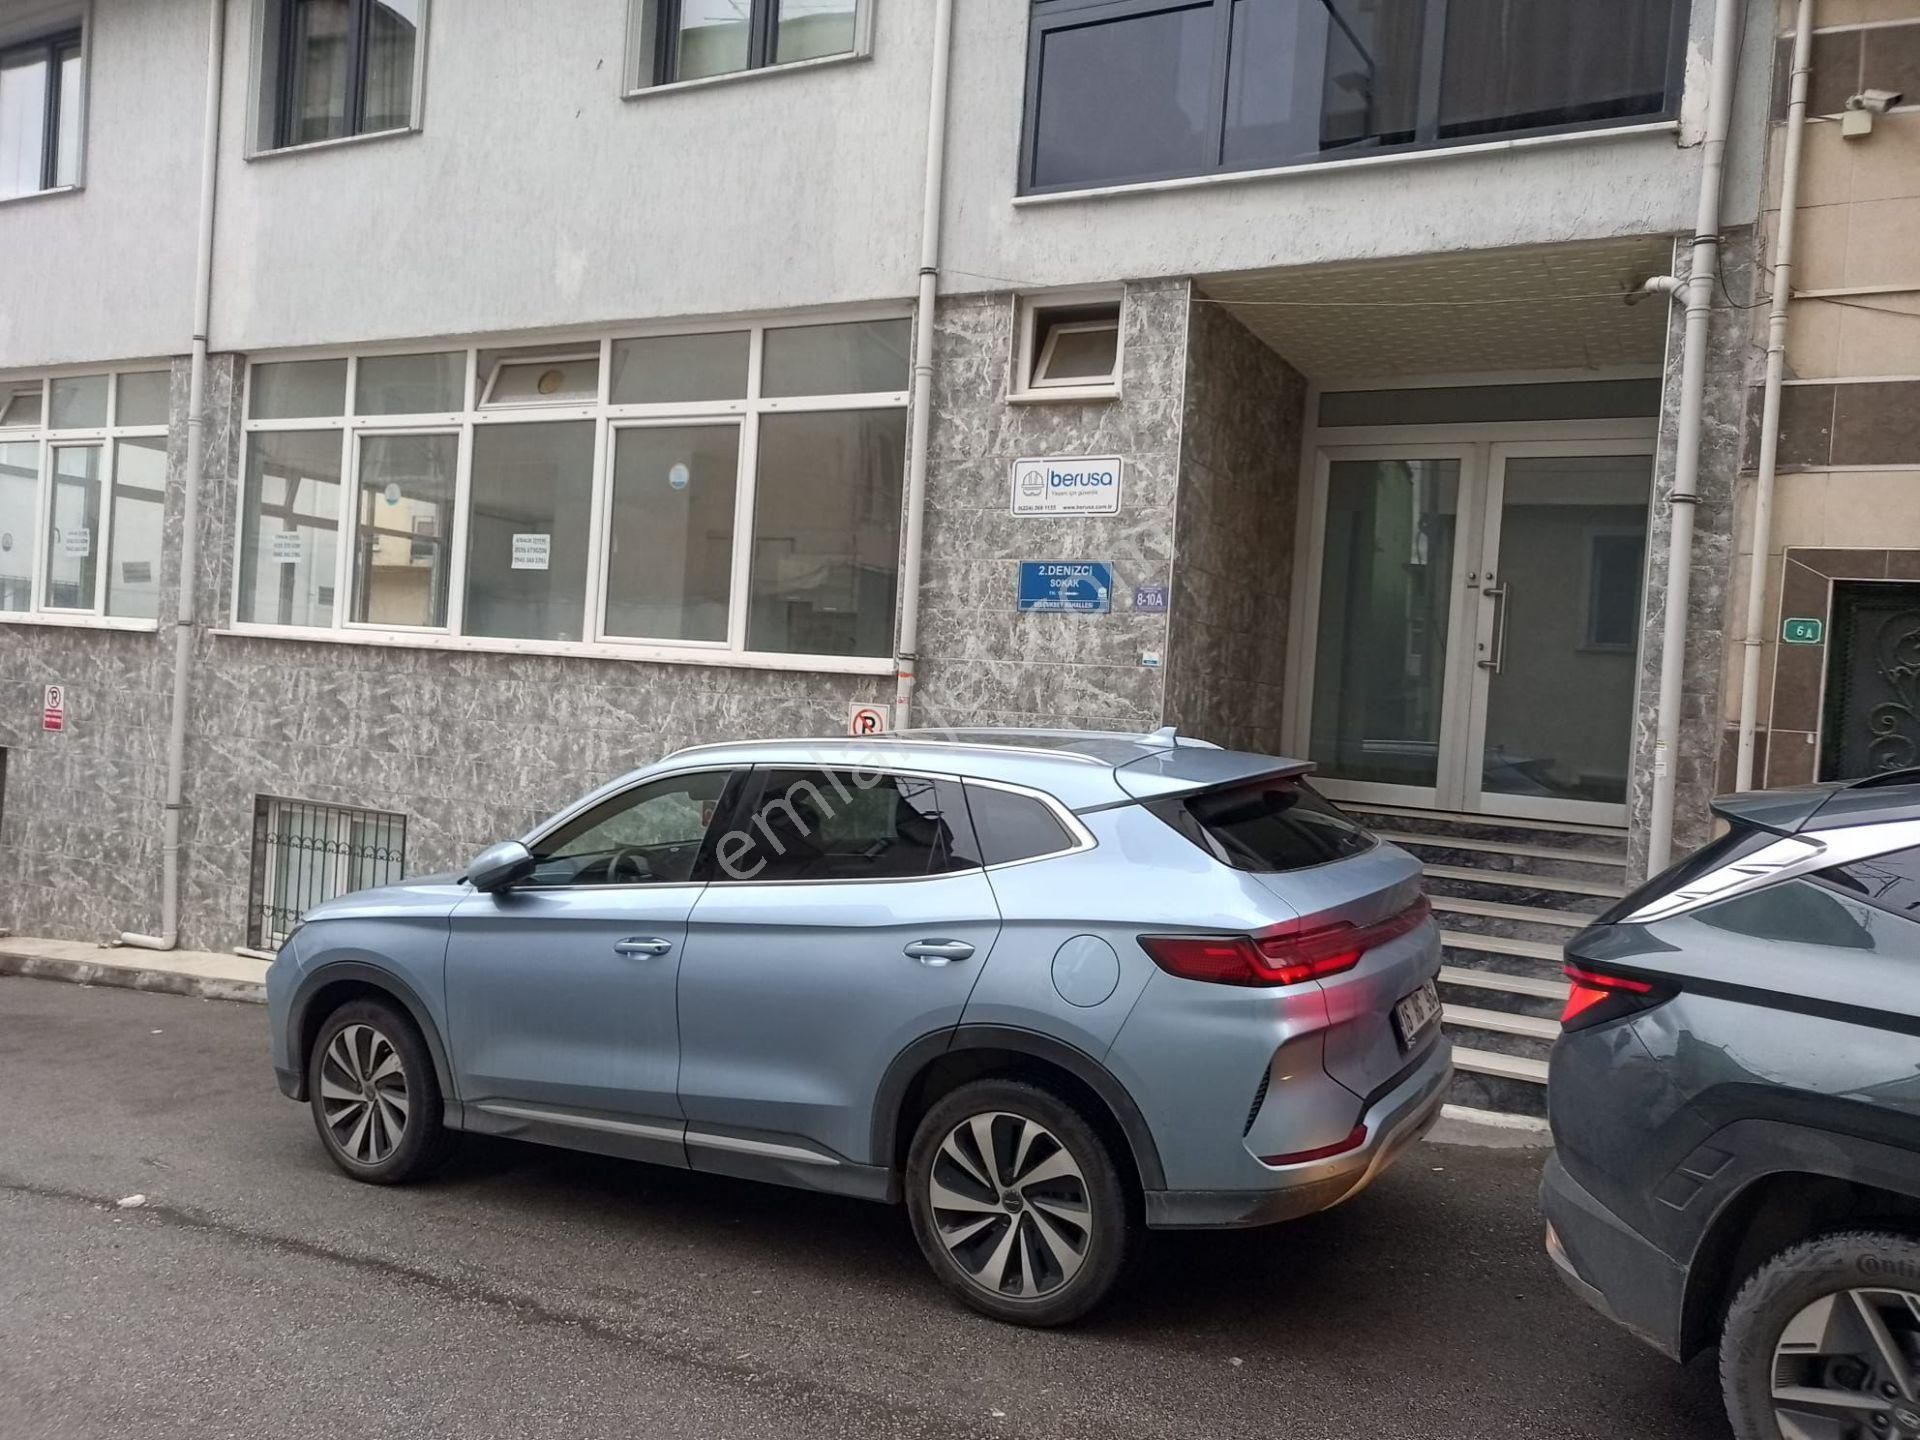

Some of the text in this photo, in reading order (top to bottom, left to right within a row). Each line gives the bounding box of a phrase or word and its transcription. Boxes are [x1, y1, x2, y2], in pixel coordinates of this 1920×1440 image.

[1050, 470, 1112, 487] berusa
[1049, 578, 1080, 588] SOKAK
[1137, 592, 1163, 606] 8-10A
